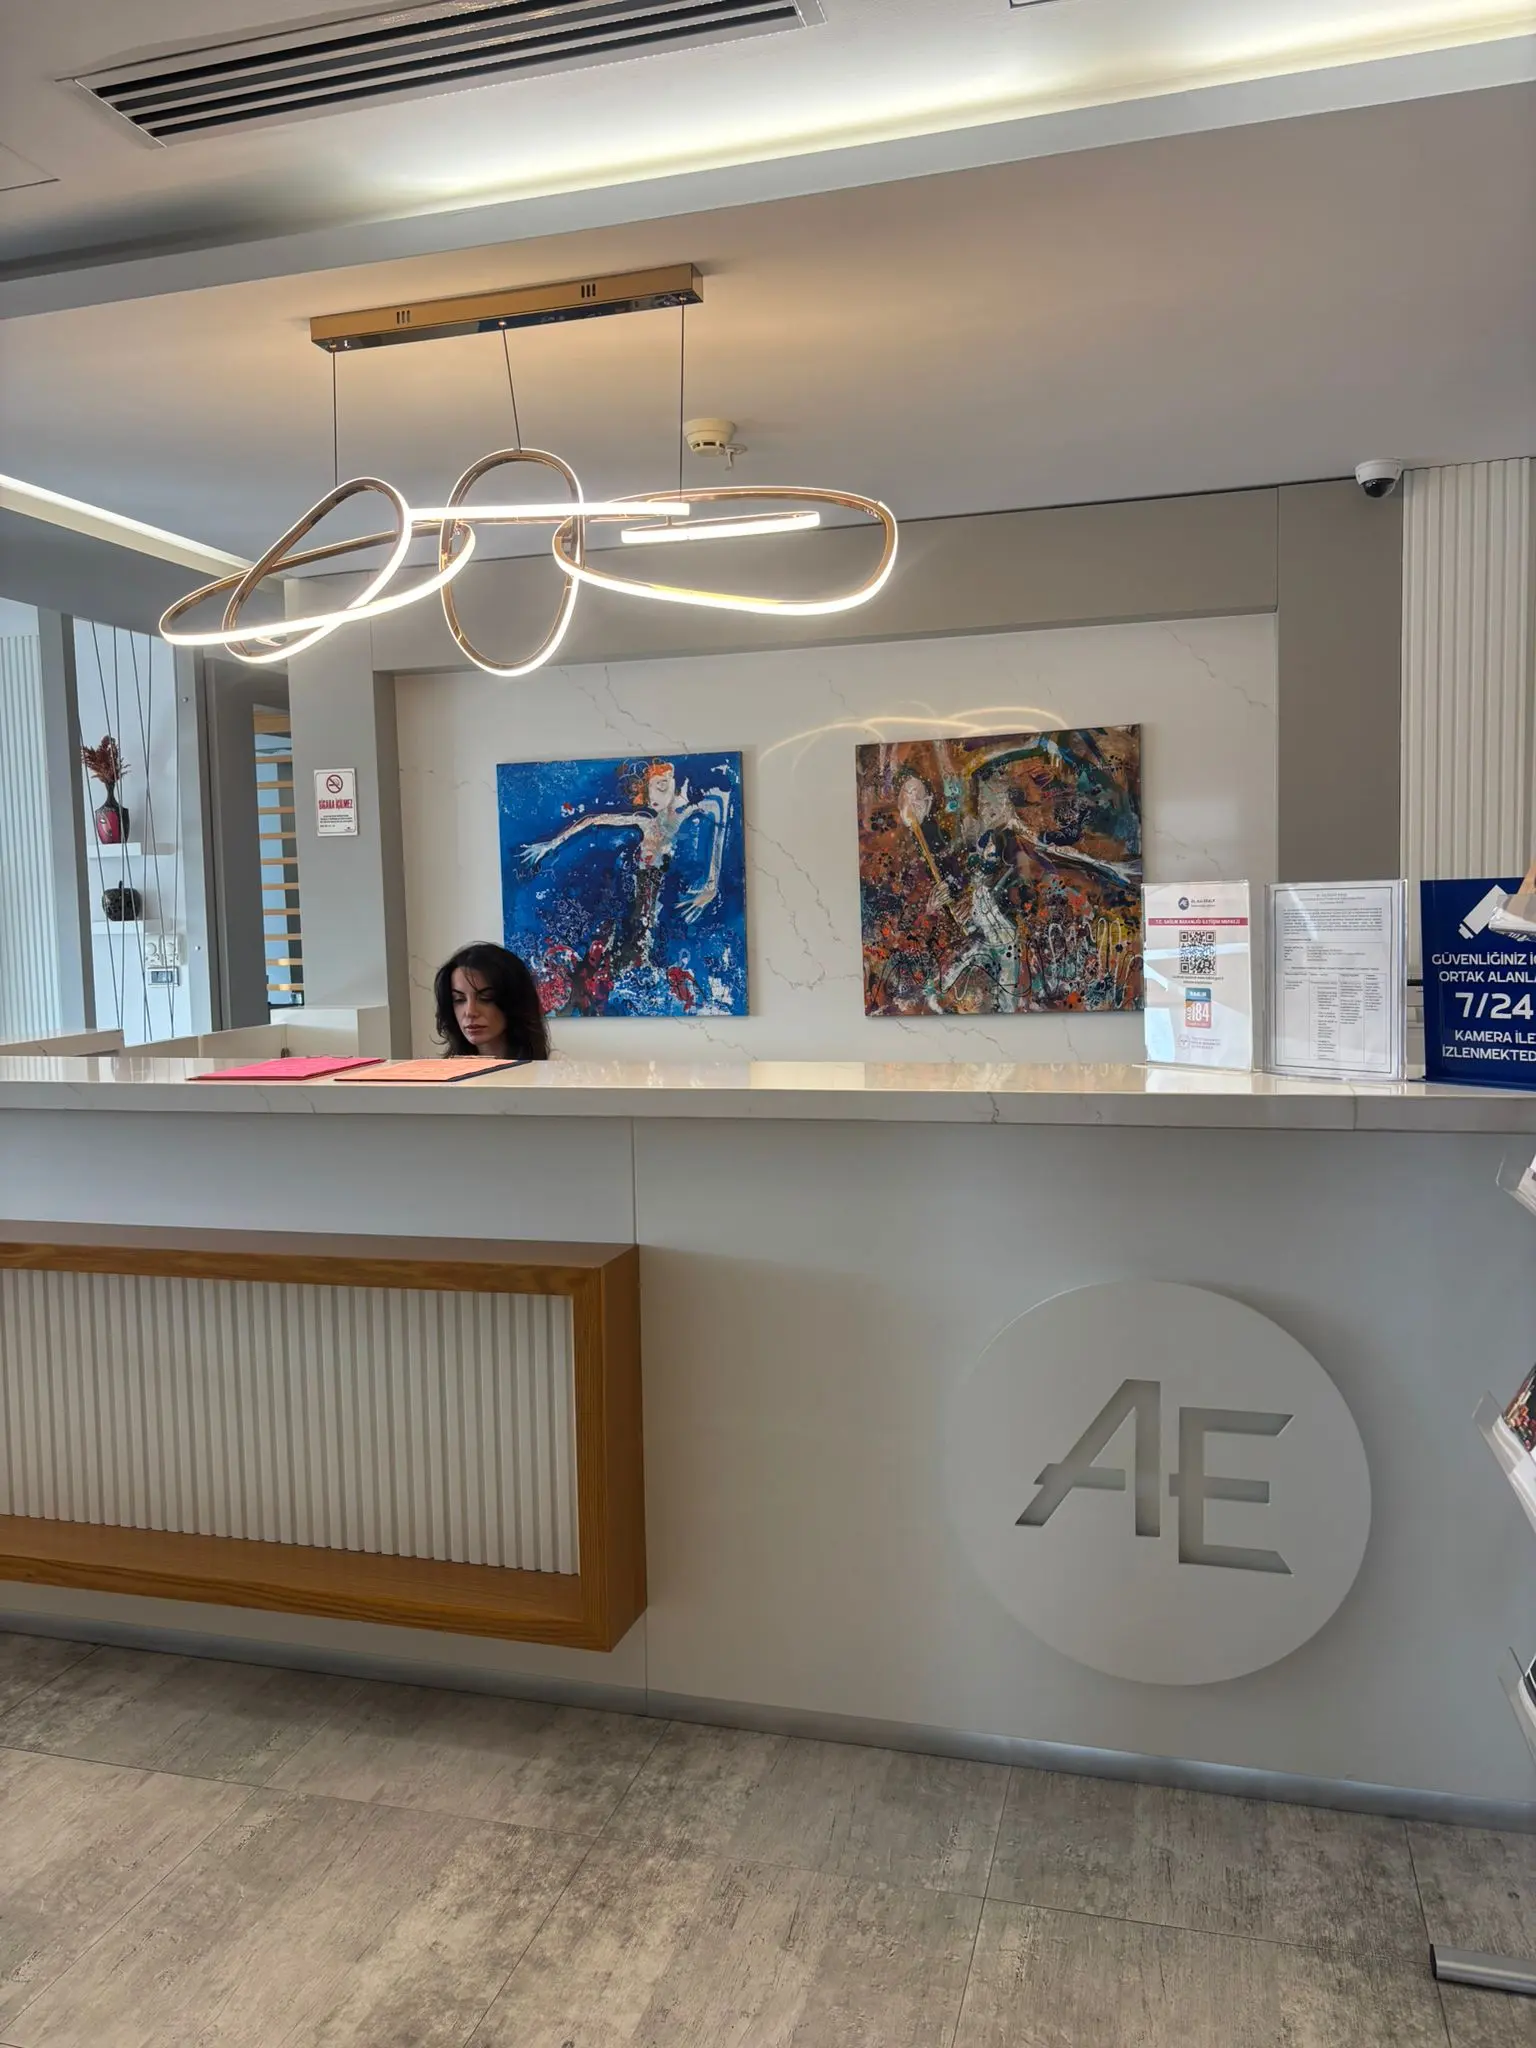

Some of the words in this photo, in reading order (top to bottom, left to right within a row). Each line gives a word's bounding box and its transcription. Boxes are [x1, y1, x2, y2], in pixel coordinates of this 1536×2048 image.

[1431, 952, 1527, 965] GÜVENLİĞİNİZ
[1439, 971, 1484, 982] ORTAK
[1488, 971, 1536, 983] ALANL
[1192, 1002, 1210, 1022] 184
[1455, 992, 1534, 1020] 7/24
[1455, 1030, 1512, 1043] KAMERA
[1515, 1030, 1536, 1044] İLE
[1015, 1378, 1295, 1576] AE
